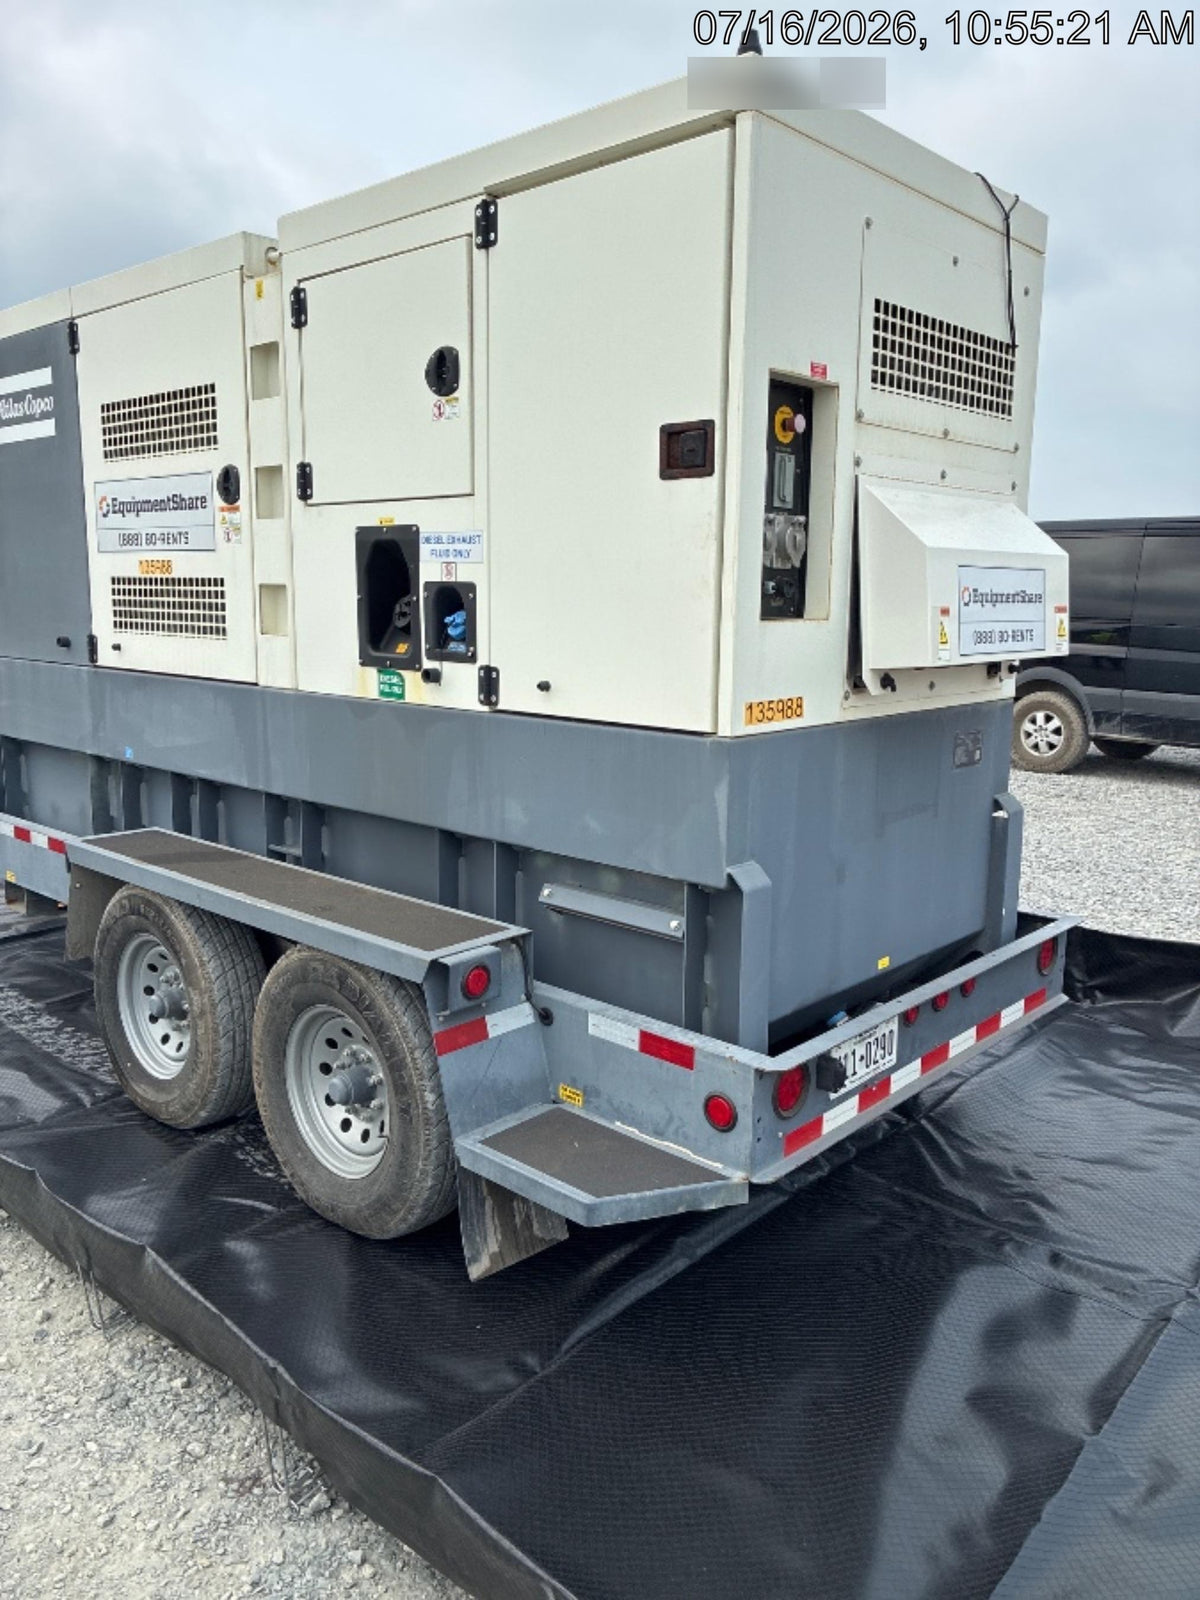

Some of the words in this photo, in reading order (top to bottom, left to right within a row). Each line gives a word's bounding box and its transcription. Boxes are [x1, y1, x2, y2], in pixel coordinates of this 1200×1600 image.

[25, 394, 54, 418] Copco
[111, 494, 207, 518] EquipmentShare
[972, 588, 1043, 607] EquipmentShare
[745, 696, 803, 724] 135988
